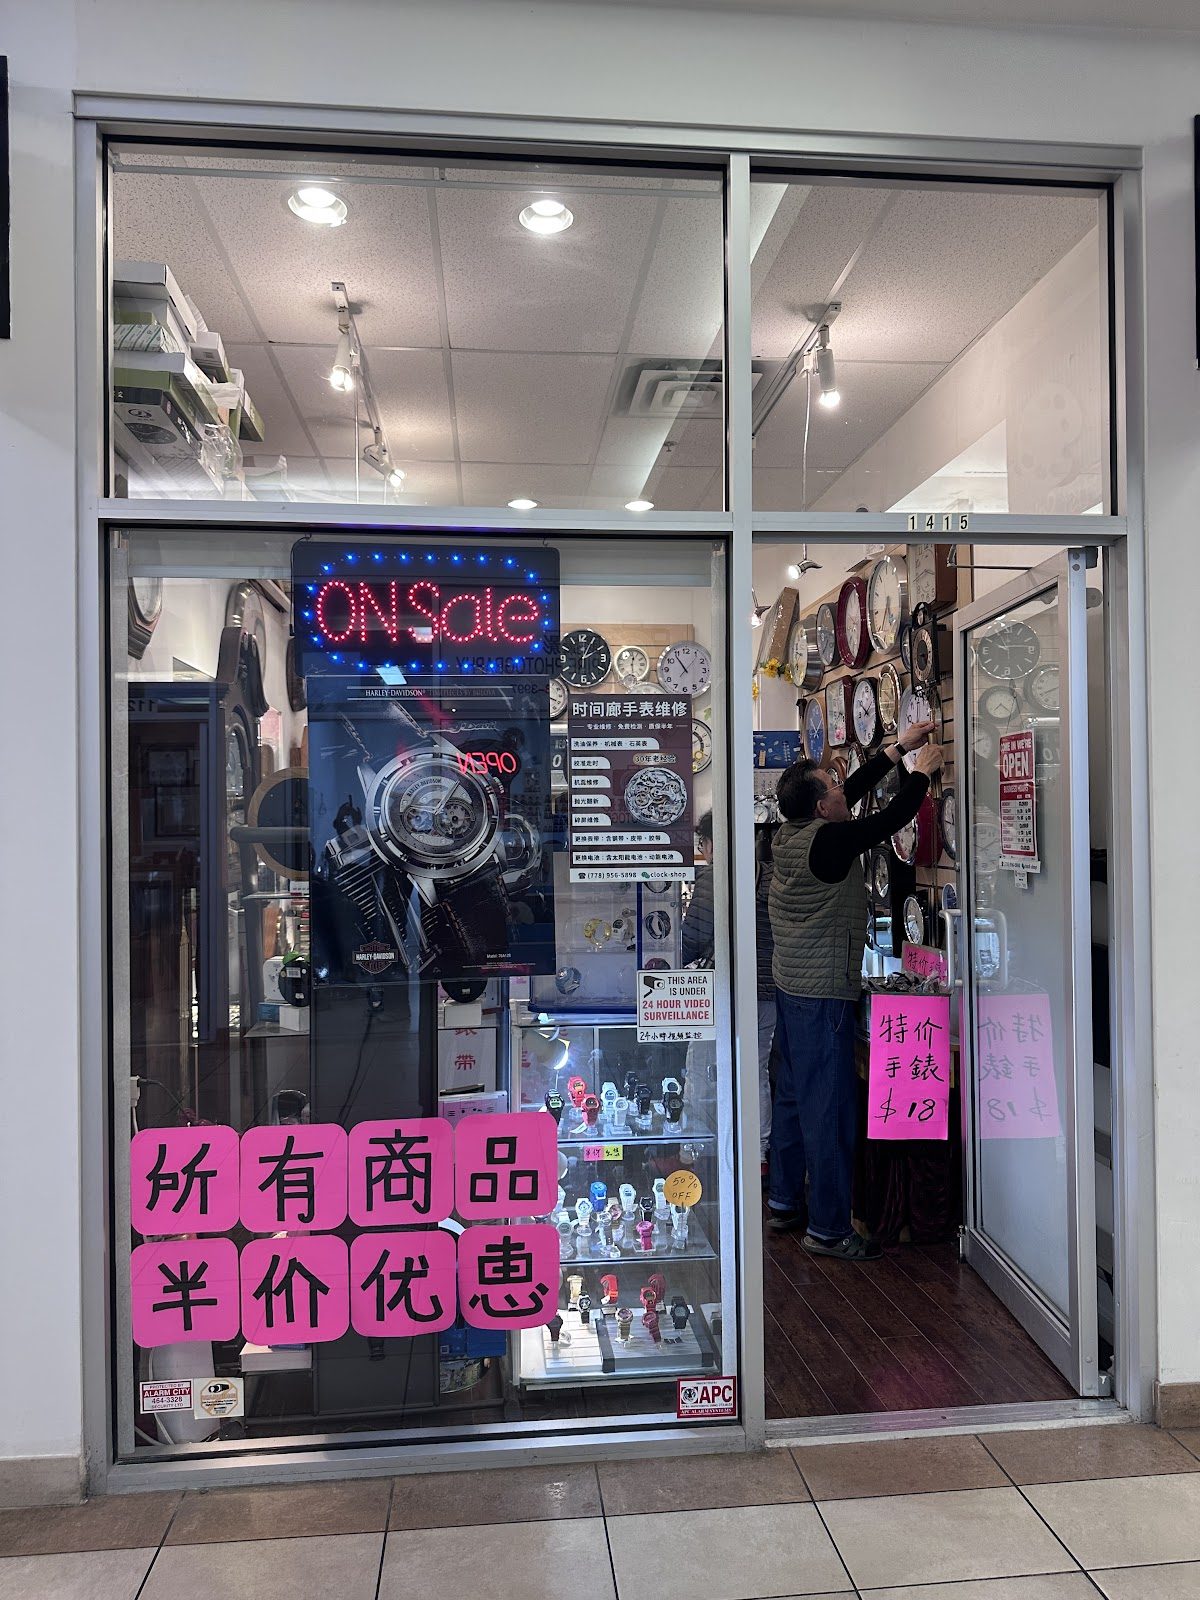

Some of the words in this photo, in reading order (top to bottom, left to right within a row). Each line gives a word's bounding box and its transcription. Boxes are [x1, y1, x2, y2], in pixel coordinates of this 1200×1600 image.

[909, 514, 968, 531] 1415
[317, 580, 398, 642] ON
[408, 580, 539, 643] Sale
[572, 701, 688, 718] 时间廊手表维修
[1002, 751, 1030, 779] OPEN
[650, 871, 687, 879] clock-shop
[668, 976, 686, 985] THIS
[687, 975, 708, 984] AREA
[669, 987, 677, 996] IS
[679, 987, 706, 996] UNDER
[642, 1000, 654, 1009] 24
[656, 999, 681, 1009] HOUR
[684, 998, 711, 1008] VIDEO
[643, 1010, 710, 1021] SURVEILLANCE
[879, 1013, 943, 1049] 特价
[145, 1129, 539, 1224] 所有商品
[672, 1175, 698, 1189] 50%
[671, 1191, 692, 1201] OFF
[152, 1235, 551, 1332] 半价优惠
[143, 1389, 171, 1398] ALARM
[172, 1388, 191, 1396] CITY
[699, 1384, 733, 1404] APC
